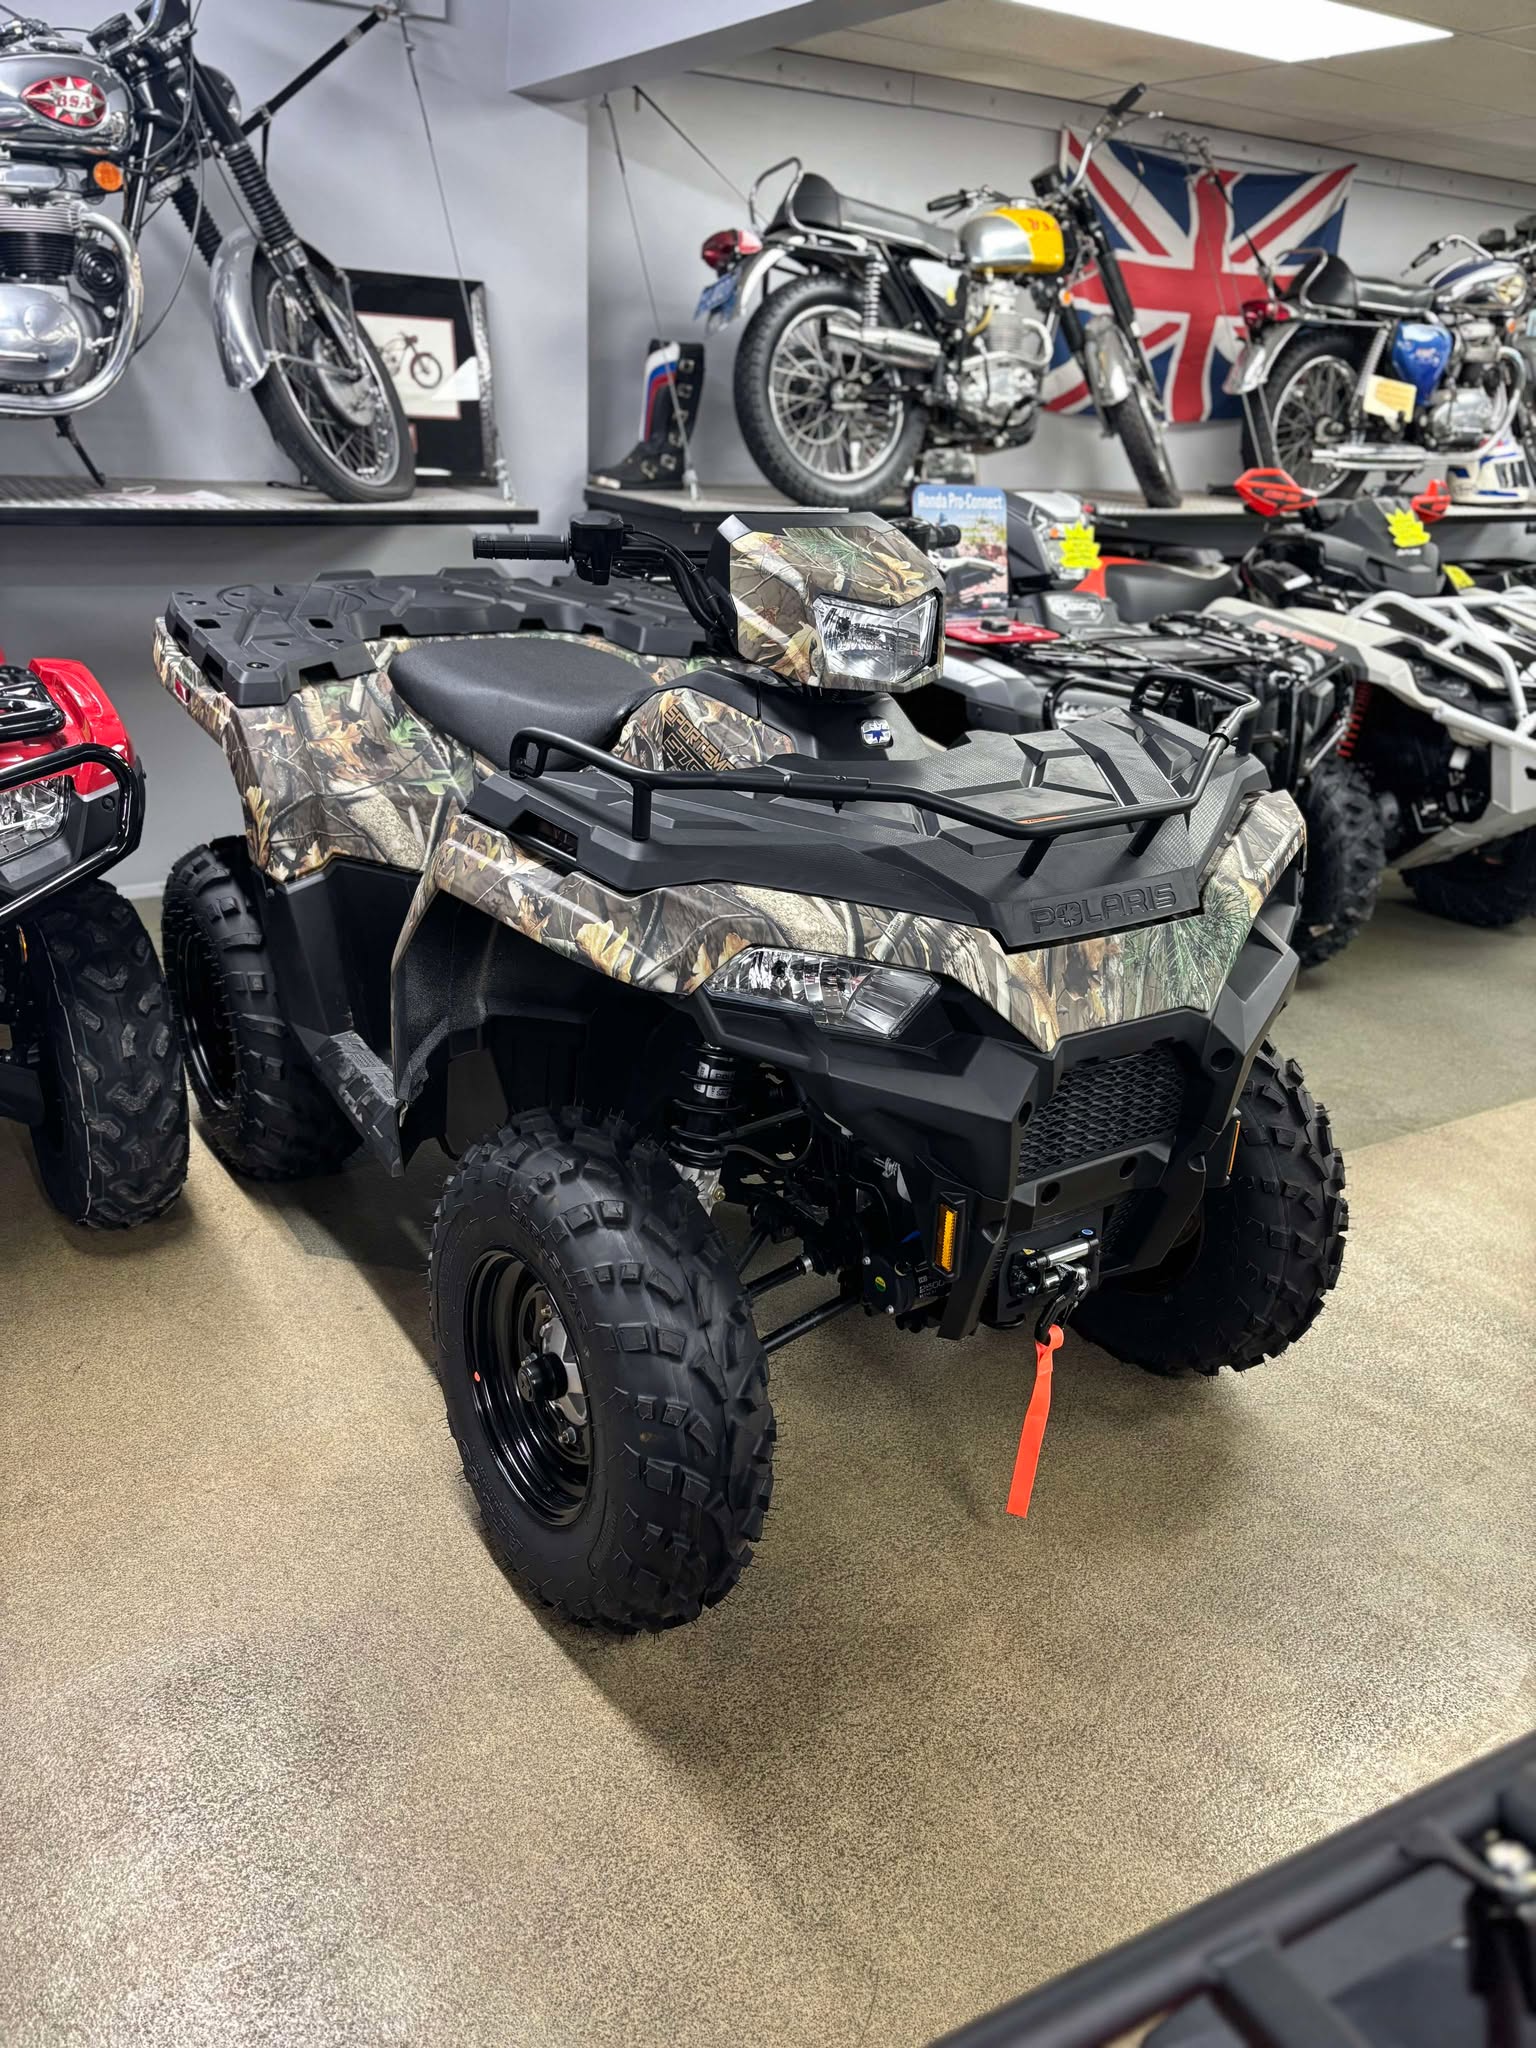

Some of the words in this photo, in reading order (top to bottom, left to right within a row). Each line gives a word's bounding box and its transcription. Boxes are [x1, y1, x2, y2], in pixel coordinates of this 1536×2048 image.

[57, 94, 93, 109] BSA
[918, 491, 947, 509] Honda
[948, 491, 1003, 510] Pro-Connect
[1029, 882, 1177, 934] POLARIS
